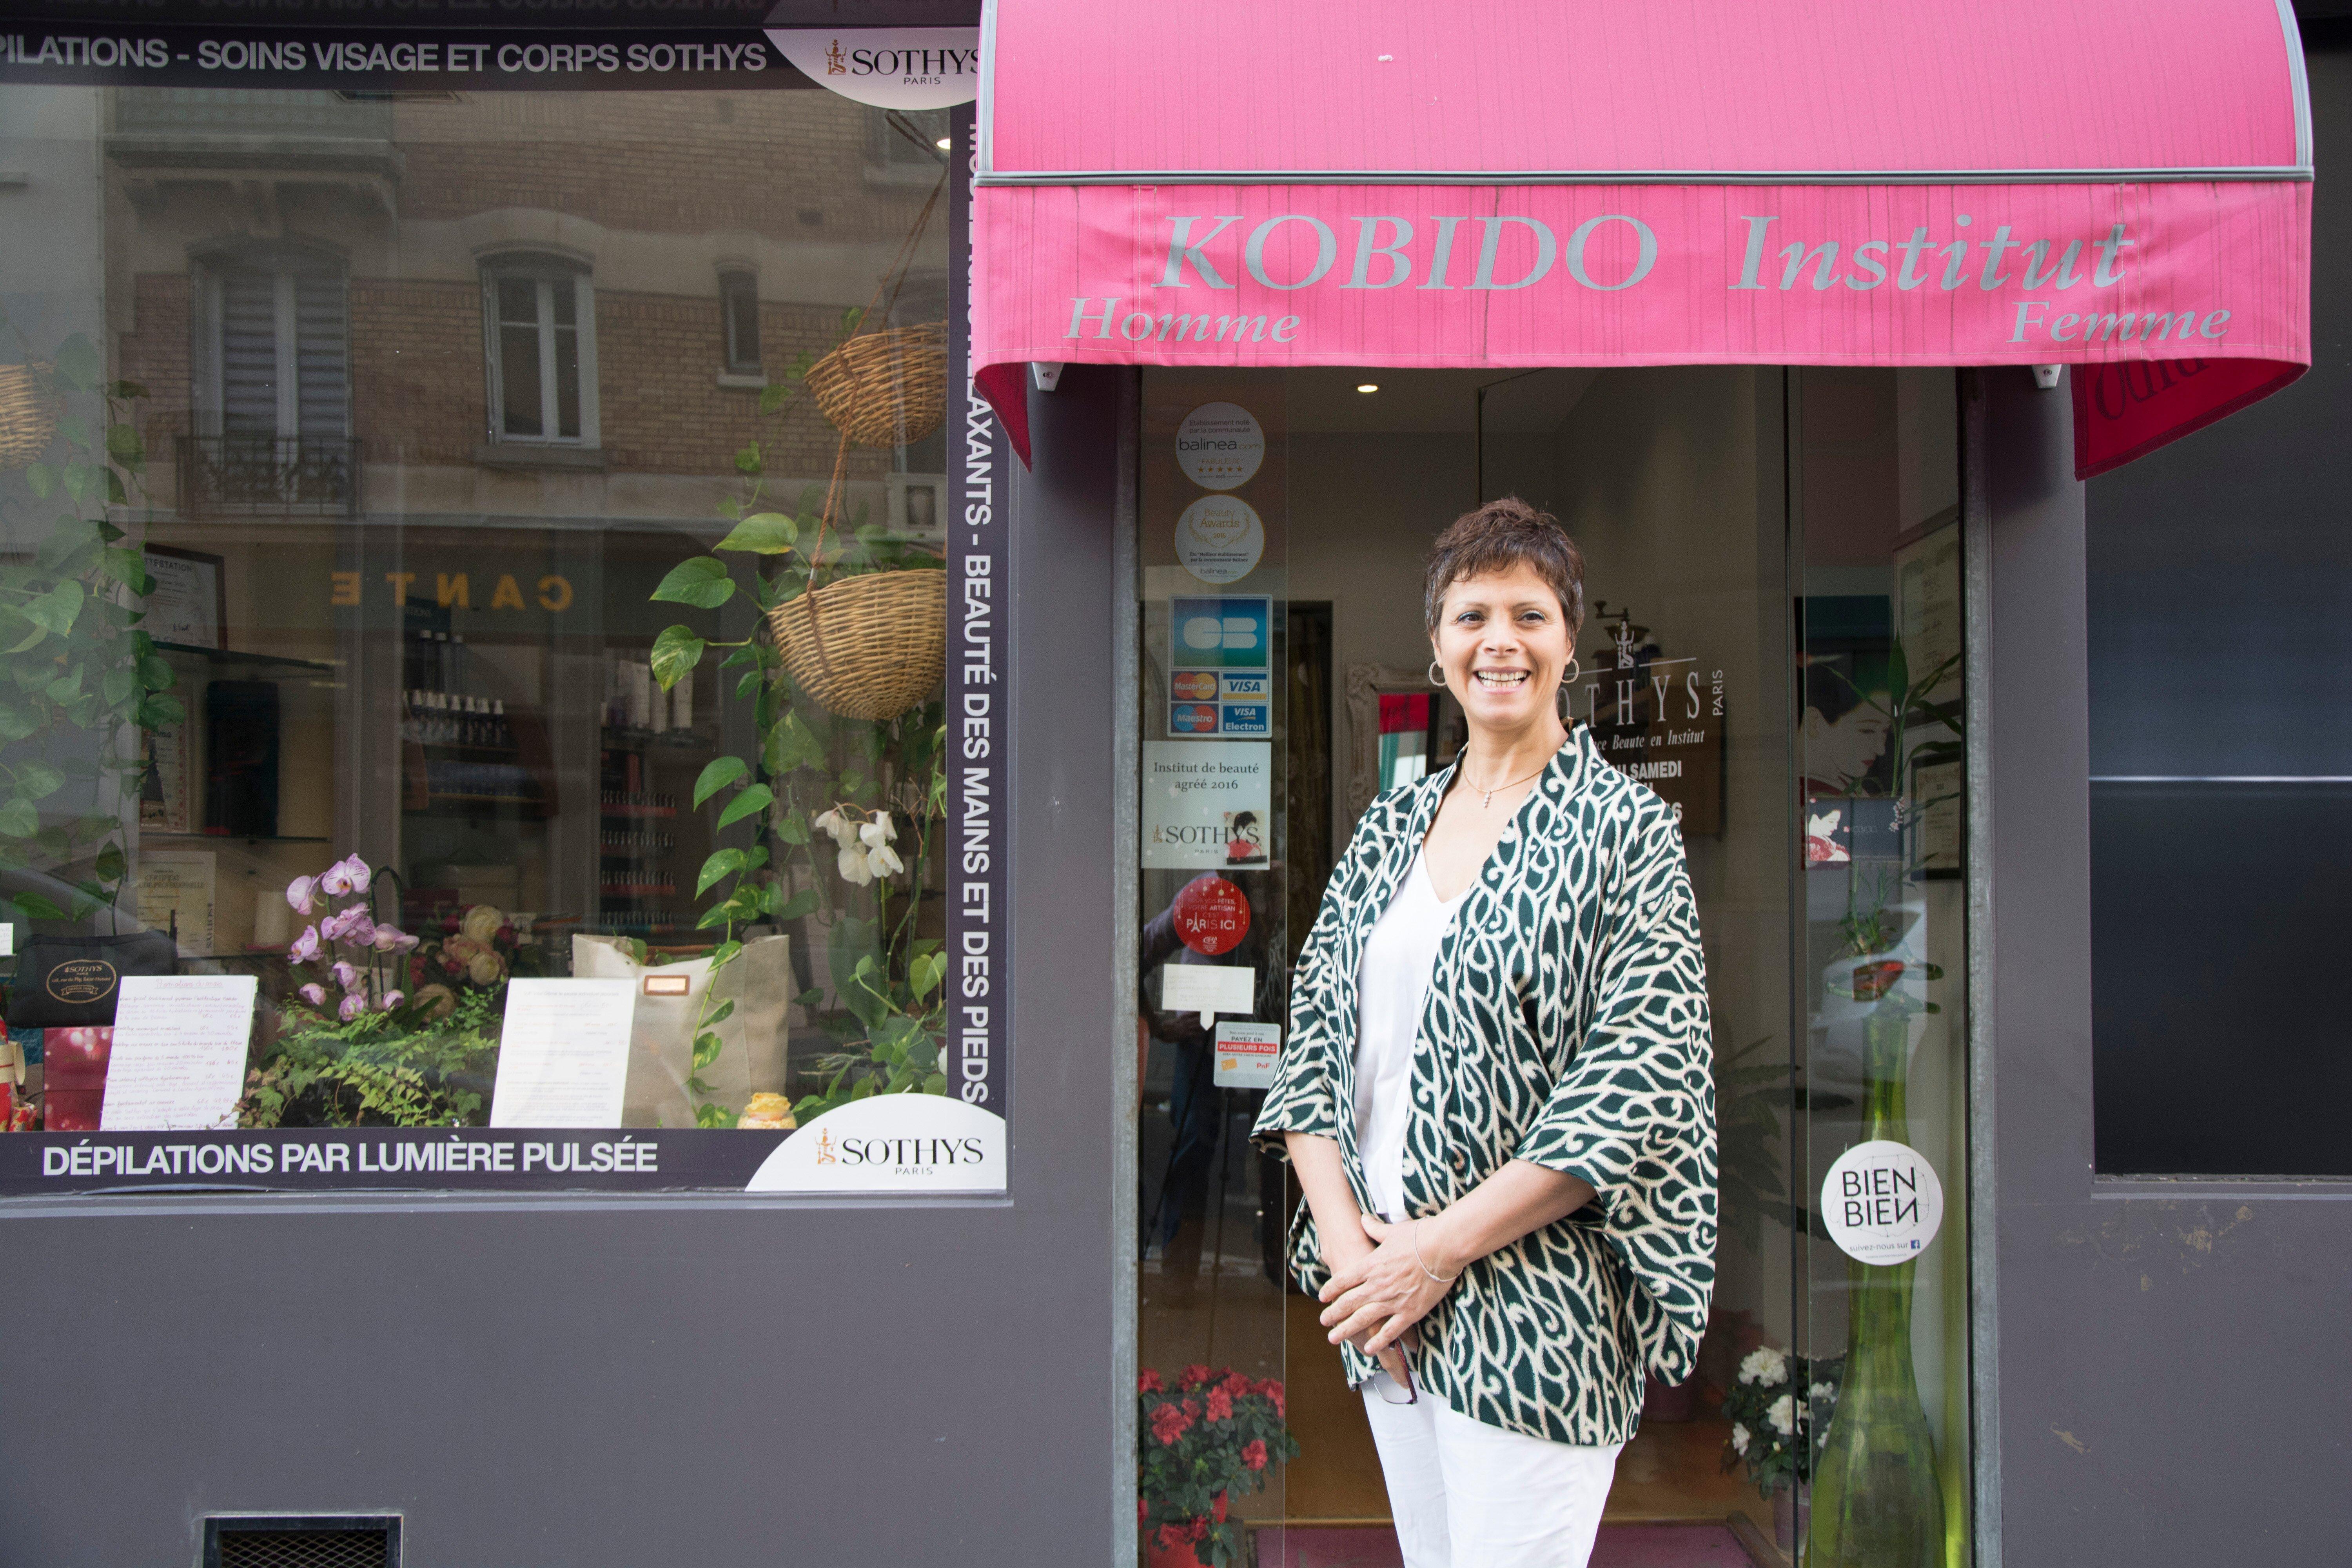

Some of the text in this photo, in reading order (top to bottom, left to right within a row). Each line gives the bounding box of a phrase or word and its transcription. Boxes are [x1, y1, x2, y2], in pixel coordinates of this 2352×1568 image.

[0, 34, 169, 68] ILATIONS
[198, 41, 307, 70] SOINS
[313, 42, 439, 71] VISAGE
[448, 44, 490, 72] ET
[498, 44, 620, 73] CORPS
[627, 43, 767, 72] SOTHYS
[904, 77, 941, 85] PARIS
[1151, 214, 2135, 291] KOBIDO Institut
[1061, 297, 1301, 343] Homme
[2006, 301, 2232, 343] Femme
[1200, 517, 1240, 528] Awards
[1204, 508, 1235, 518] Beauty
[964, 555, 997, 685] BEAUTÉ
[1174, 682, 1216, 691] MasterCard
[1230, 681, 1261, 692] VISA
[1713, 670, 1723, 715] PARIS
[1177, 714, 1213, 723] Maestro
[1234, 708, 1256, 716] VISA
[964, 695, 990, 759] DES
[1225, 722, 1265, 731] Electron
[1613, 734, 1644, 750] Beaute
[1651, 736, 1661, 746] en
[1667, 728, 1705, 745] Institut
[1154, 762, 1259, 773] Institut de beauté
[1630, 760, 1682, 779] SAMEDI
[1174, 779, 1238, 792] agréé 2016
[963, 767, 989, 874] MAINS
[1165, 826, 1260, 845] SOTHYS
[963, 883, 989, 923] ET
[1187, 913, 1235, 933] PARIS ICI
[963, 931, 989, 998] DES
[962, 1006, 988, 1103] PIEDS
[43, 1134, 658, 1176] DÉPILATIONS PAR LUMIÈRE PULSÉE
[842, 1138, 984, 1165] SOTHYS
[895, 1167, 933, 1175] PARIS
[1842, 1167, 1916, 1197] BIEN
[1849, 1243, 1895, 1252] suivez-nous
